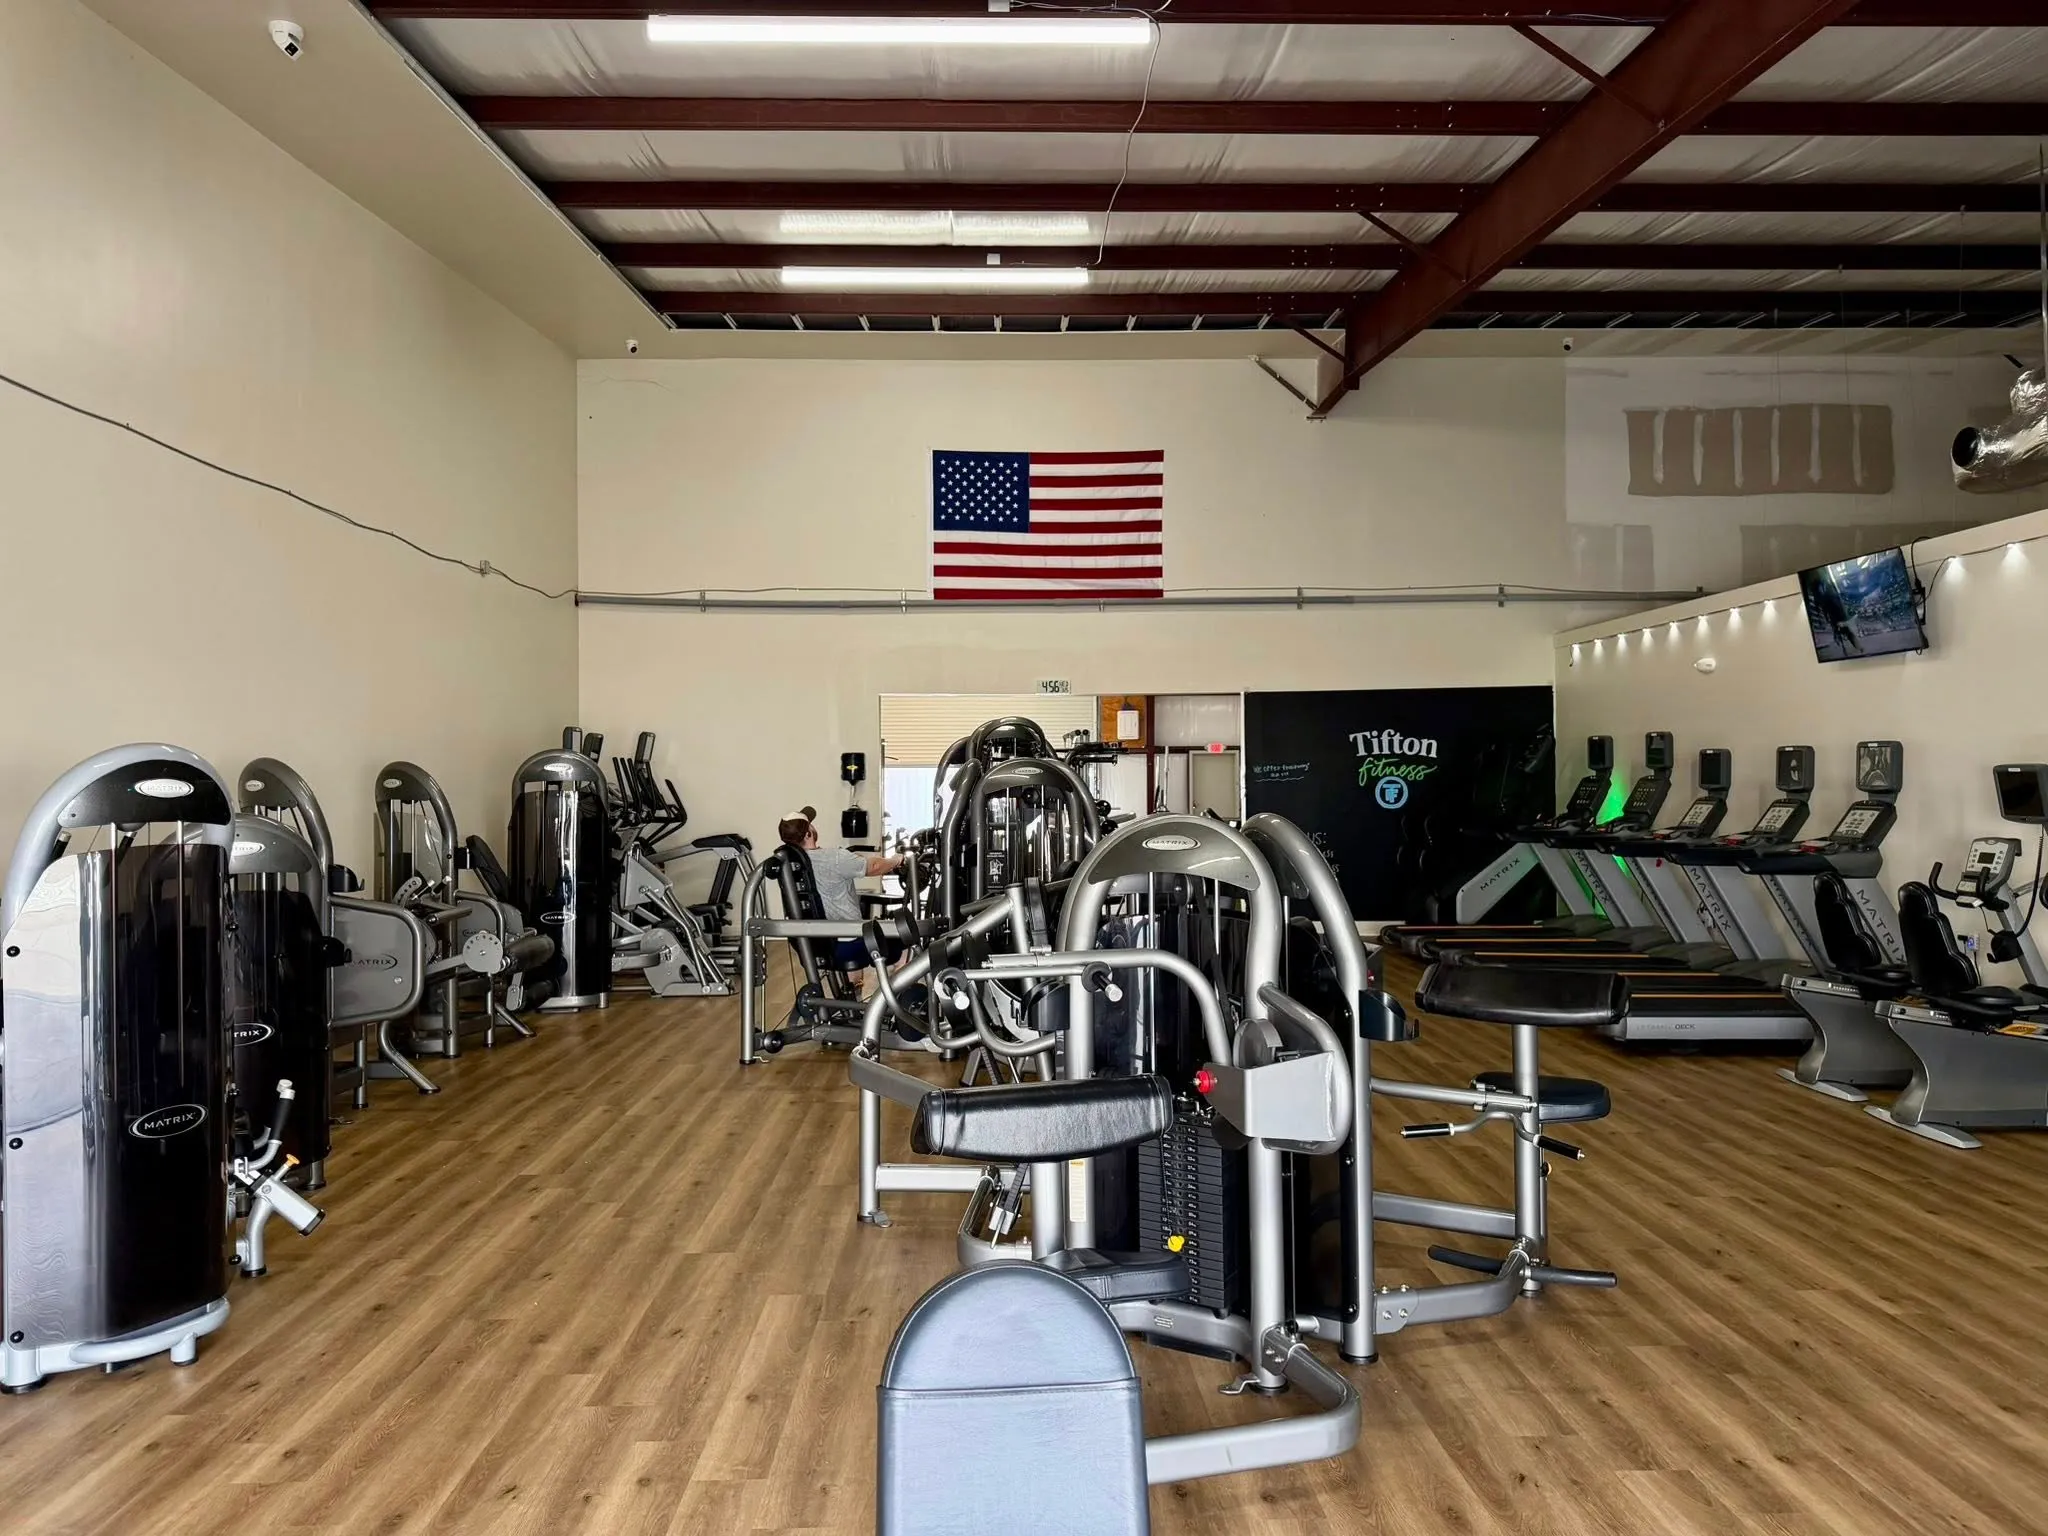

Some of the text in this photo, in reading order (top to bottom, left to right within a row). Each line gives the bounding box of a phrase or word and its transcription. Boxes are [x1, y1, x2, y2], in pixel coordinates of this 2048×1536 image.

[1349, 728, 1438, 758] Tifton
[1358, 757, 1438, 787] fitness
[1480, 857, 1521, 892] MATRIX
[1575, 849, 1612, 903] MATRIX
[1690, 867, 1731, 931] MATRIX
[234, 1029, 262, 1038] TRIX
[144, 1111, 196, 1130] MATRIX
